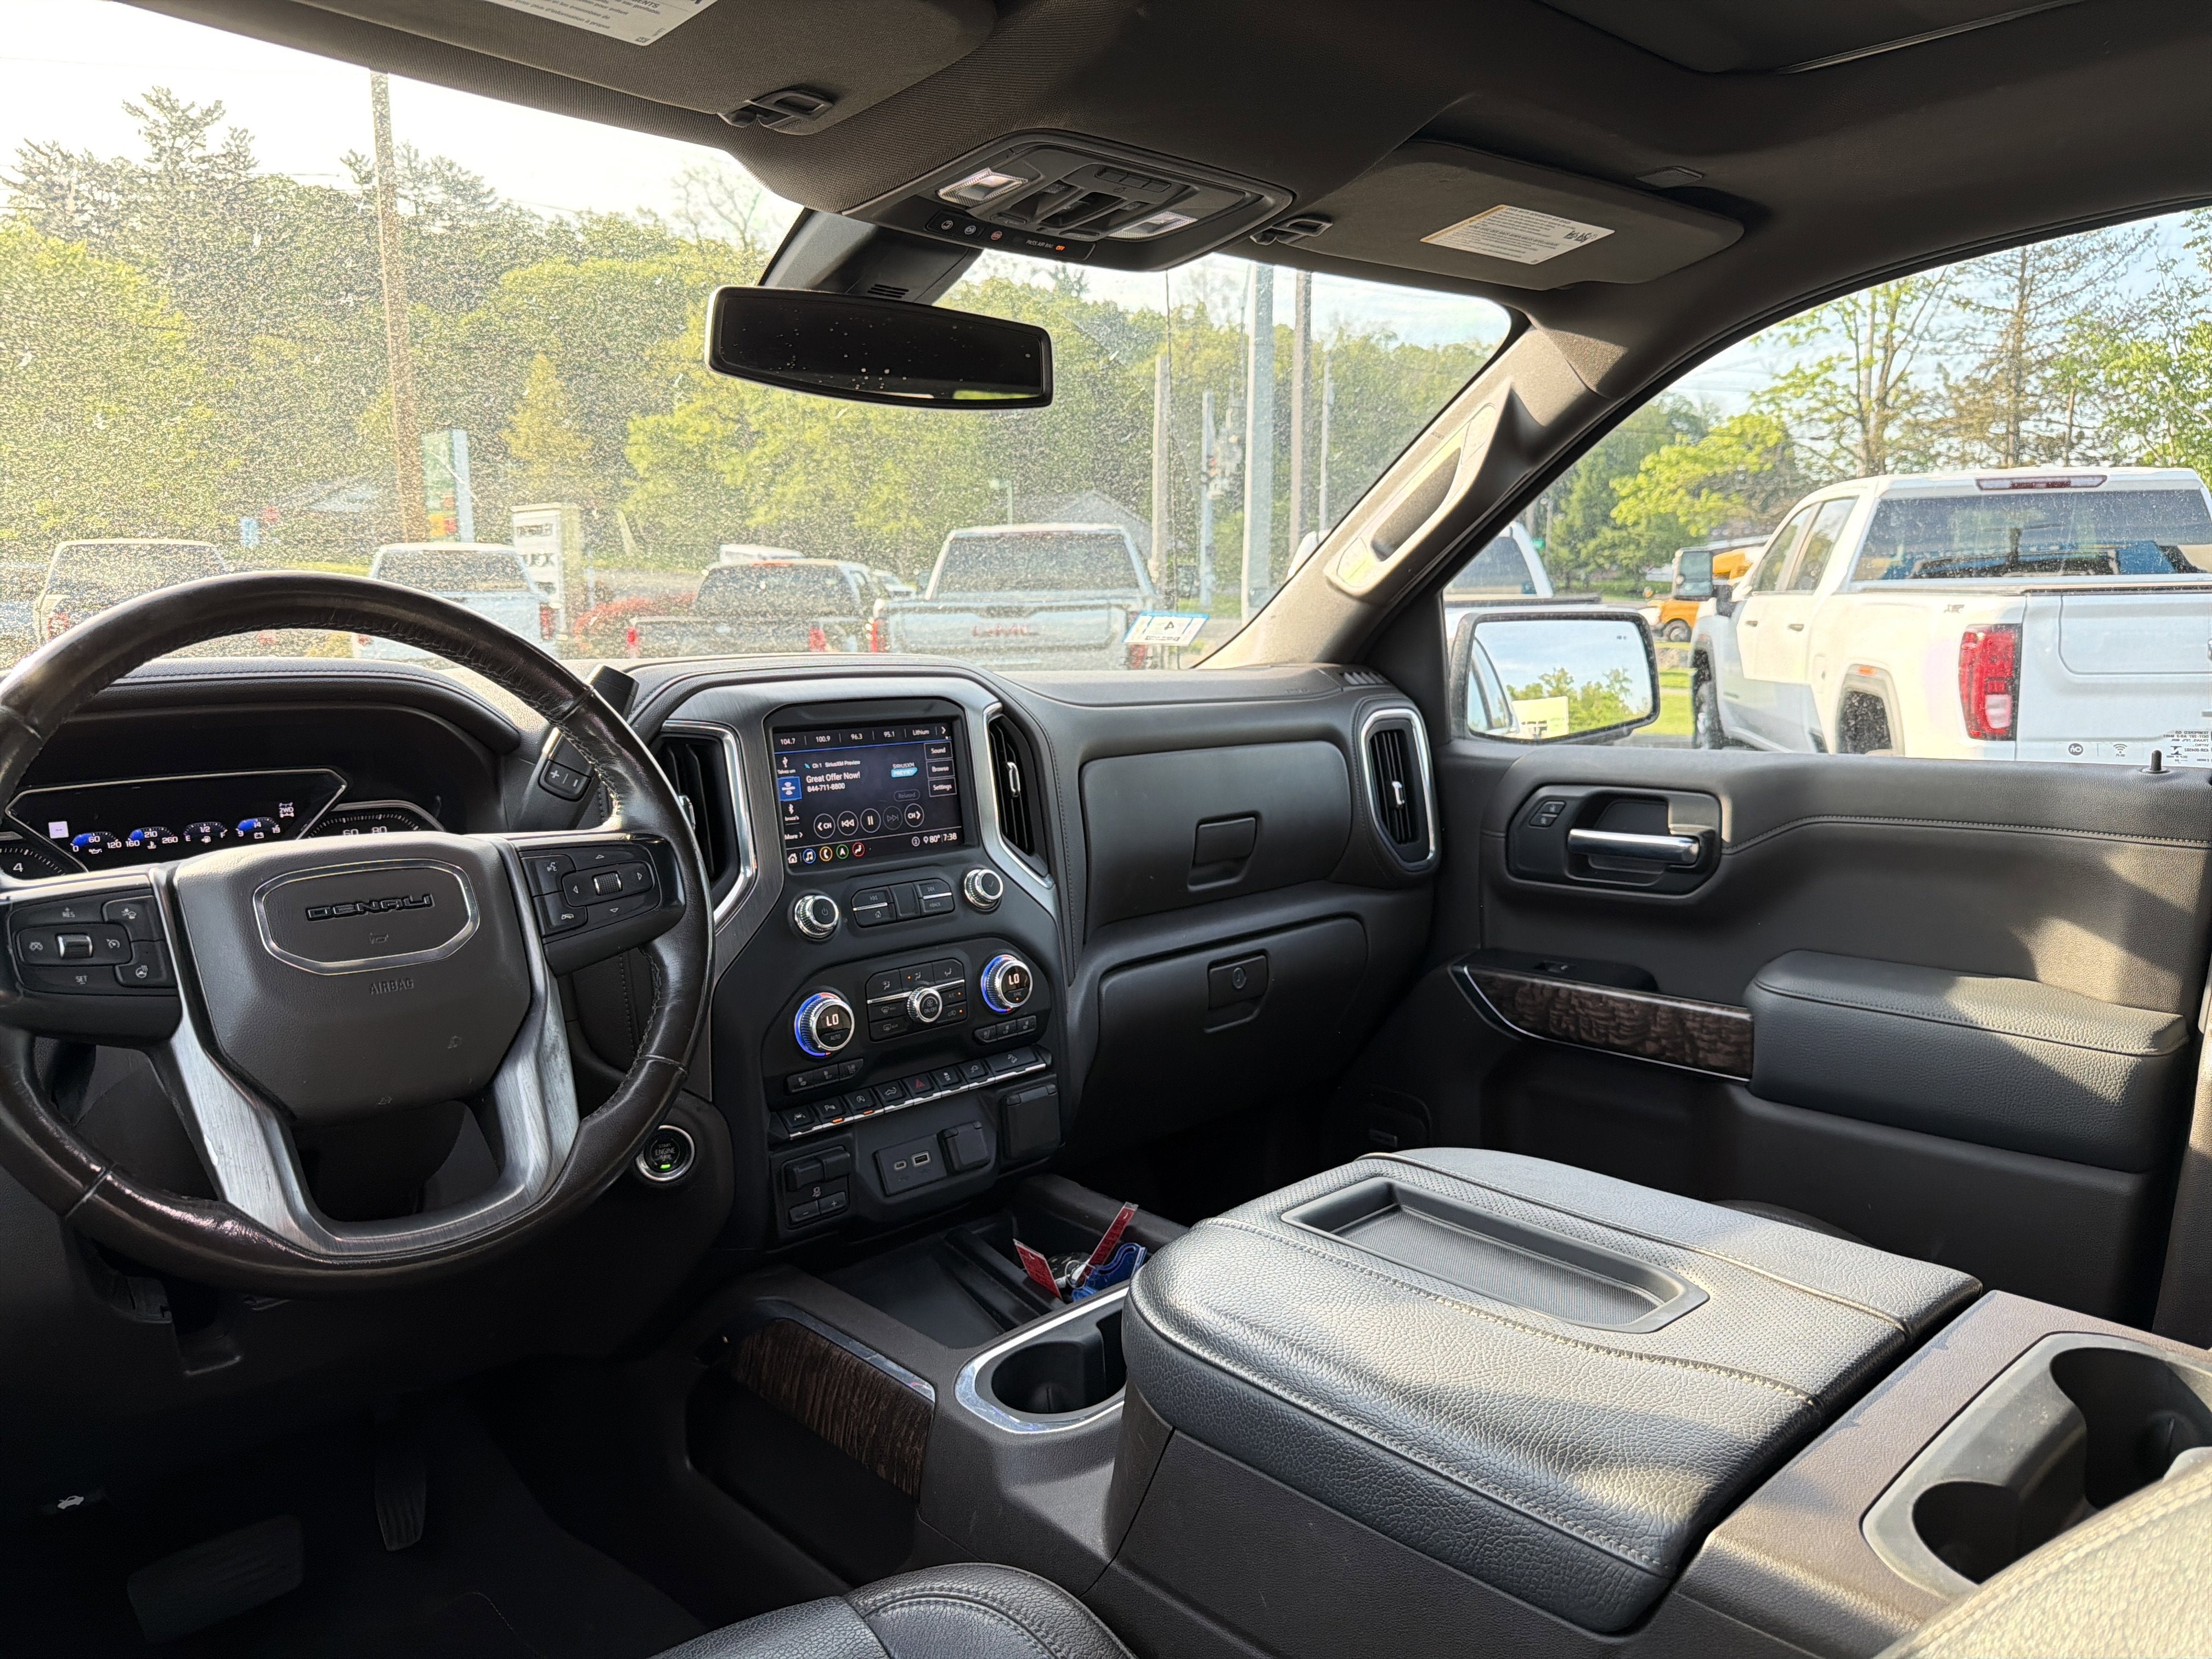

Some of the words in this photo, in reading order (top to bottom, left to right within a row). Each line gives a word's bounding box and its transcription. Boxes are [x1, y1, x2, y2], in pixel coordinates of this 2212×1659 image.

[806, 774, 825, 783] Great
[826, 772, 843, 781] Offer
[843, 771, 861, 779] Now!
[807, 783, 845, 792] 844-711-8800
[933, 783, 952, 792] Settings
[943, 833, 957, 841] 7:38
[13, 862, 24, 872] 4
[306, 894, 434, 921] DENALI
[1008, 973, 1020, 985] LO
[370, 979, 414, 995] AIRBAG
[826, 1014, 839, 1026] LO
[655, 1147, 675, 1155] ENGINE
